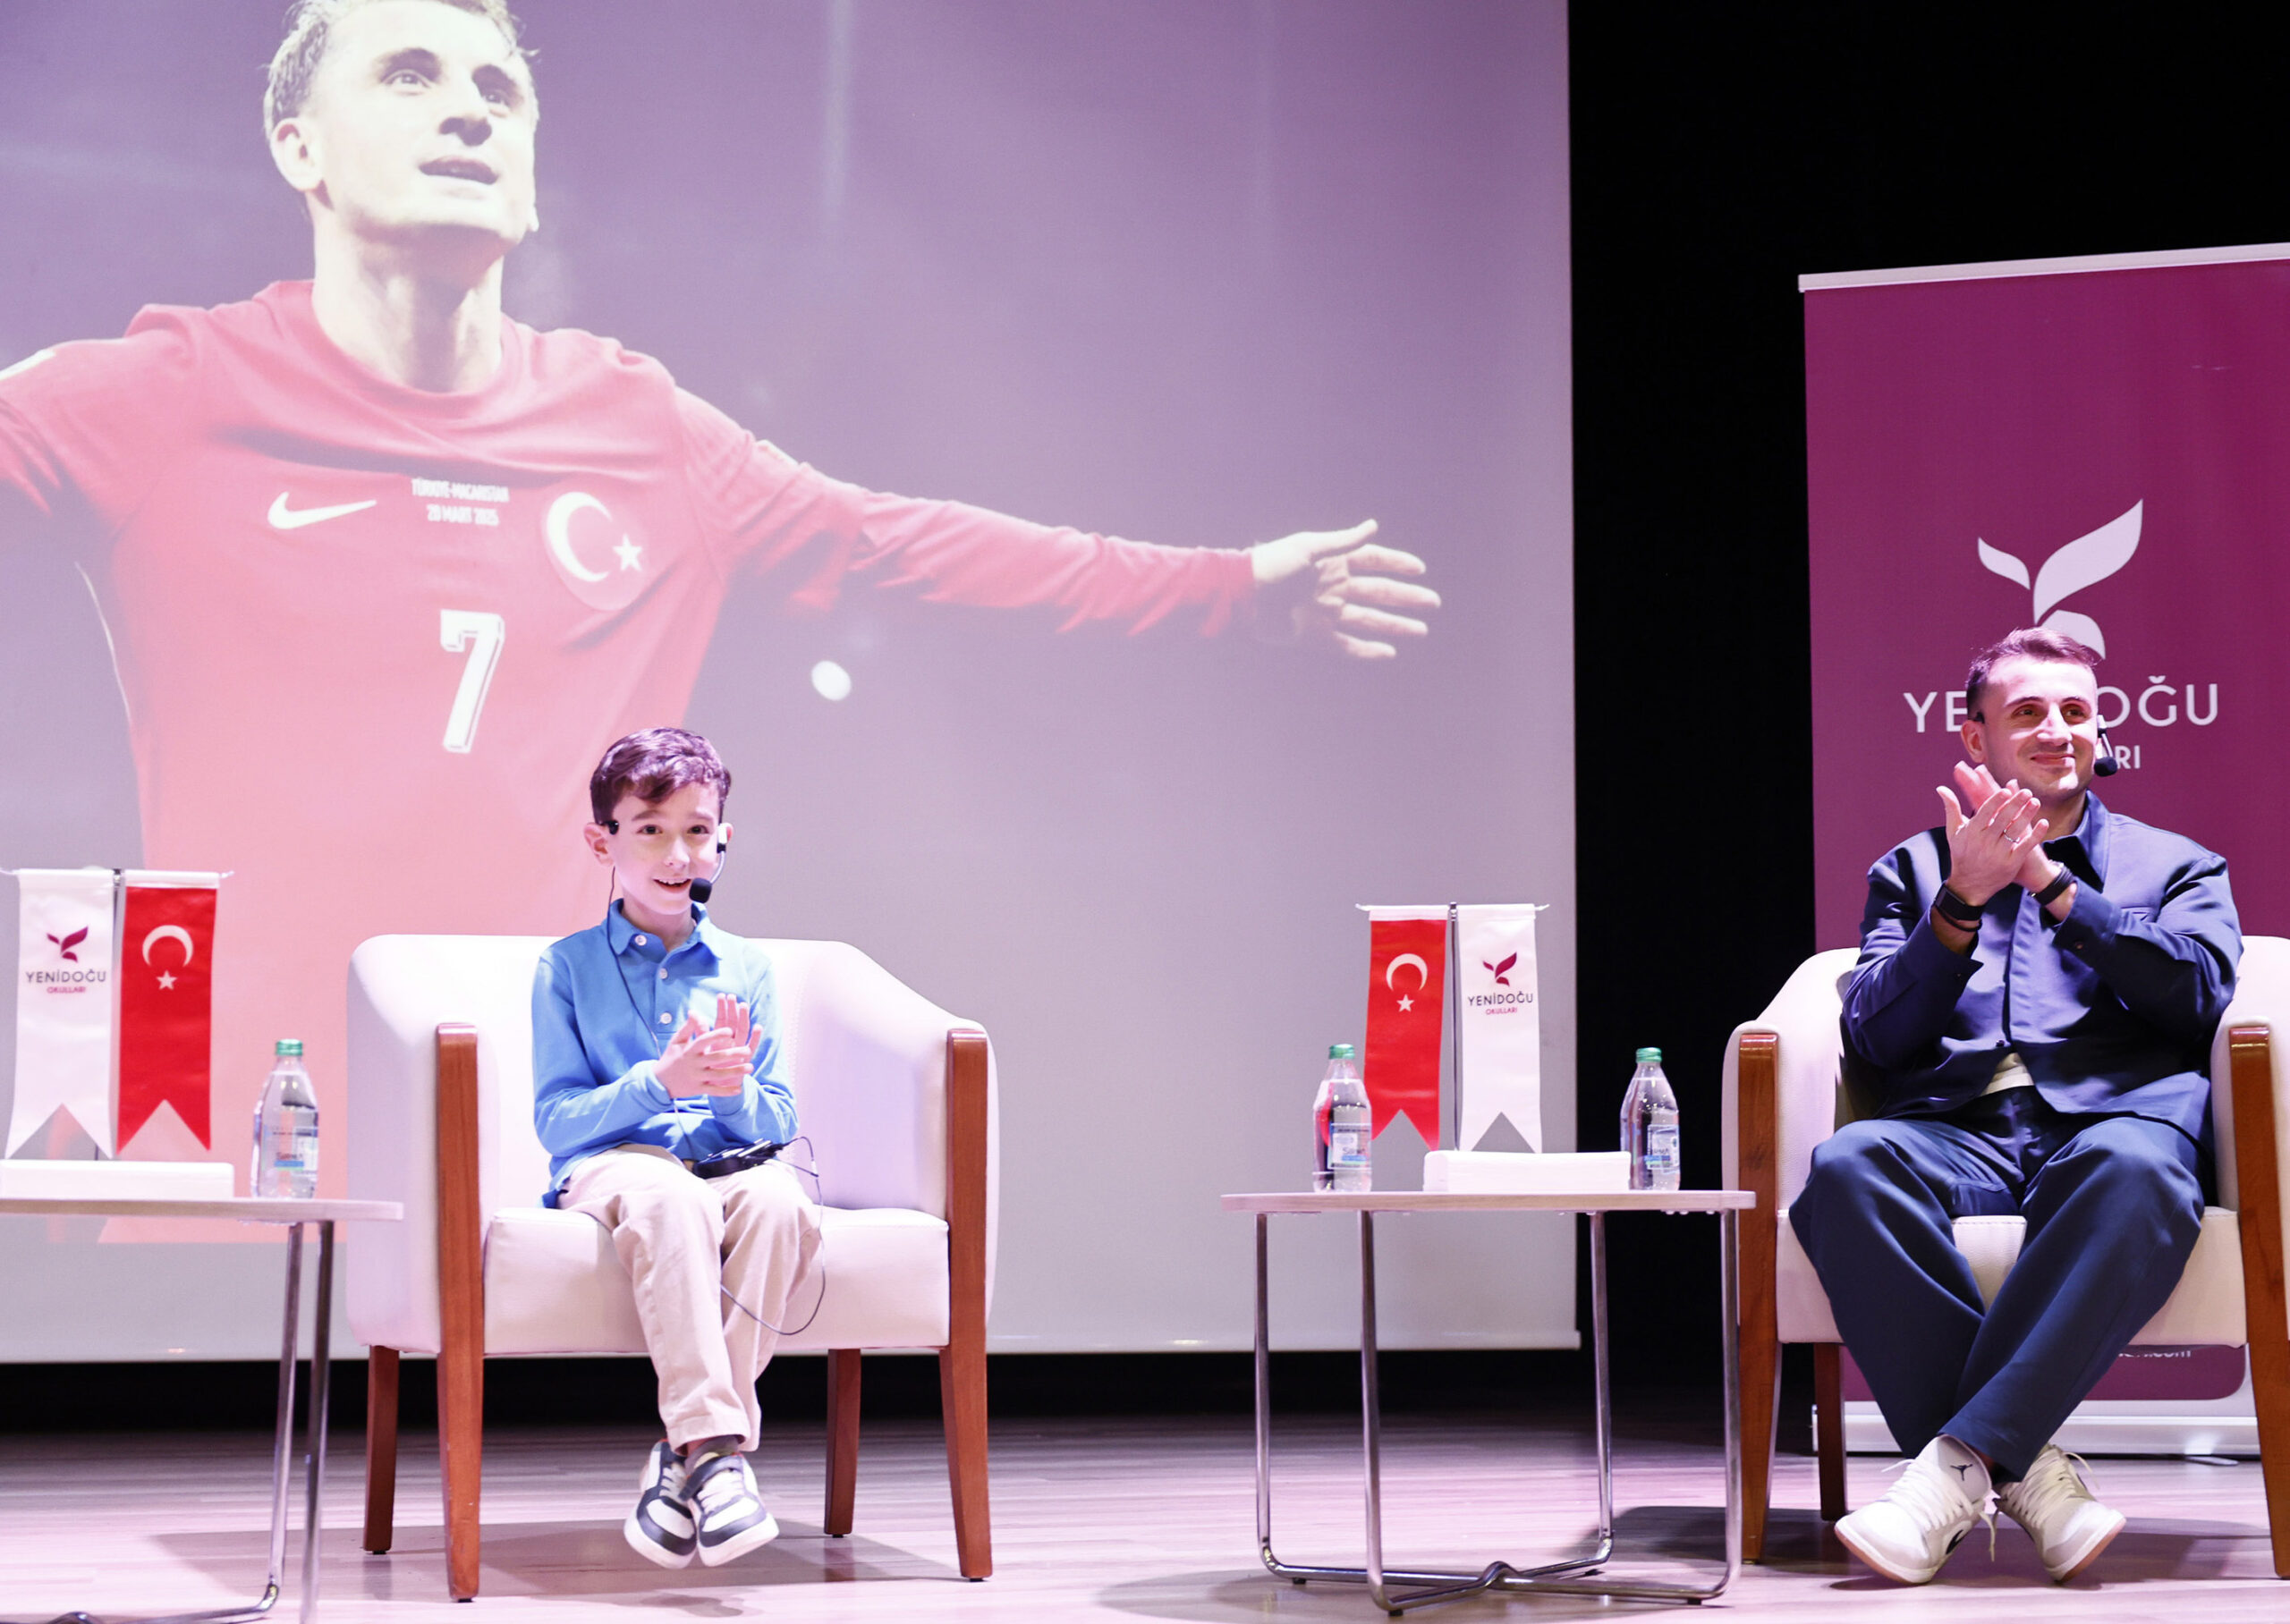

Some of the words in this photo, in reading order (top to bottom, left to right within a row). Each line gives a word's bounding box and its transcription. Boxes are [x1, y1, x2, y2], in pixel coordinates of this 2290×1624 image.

[440, 609, 505, 754] 7
[1903, 675, 2218, 733] YEOĞU
[25, 968, 106, 983] YENİDOĞU
[1468, 990, 1533, 1006] YENİDOĞU
